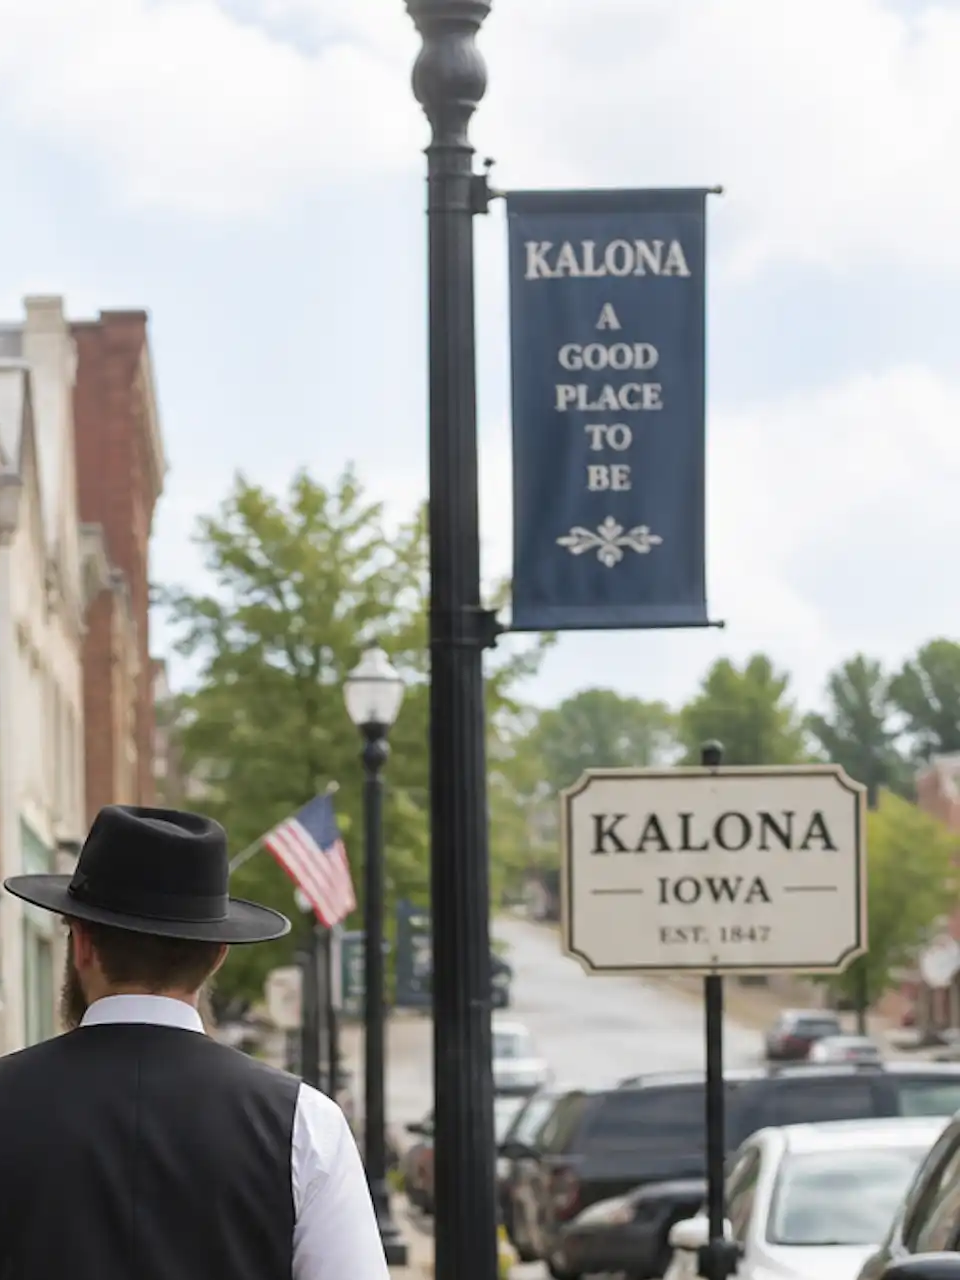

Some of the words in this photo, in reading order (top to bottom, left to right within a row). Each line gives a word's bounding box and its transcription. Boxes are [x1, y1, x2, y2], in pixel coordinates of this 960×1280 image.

[524, 239, 691, 280] KALONA
[595, 302, 622, 331] A
[558, 342, 659, 371] GOOD
[554, 382, 663, 412] PLACE
[585, 423, 632, 452] TO
[587, 464, 632, 492] BE
[590, 810, 838, 855] KALONA
[657, 876, 772, 905] IOWA
[719, 925, 772, 944] 1847
